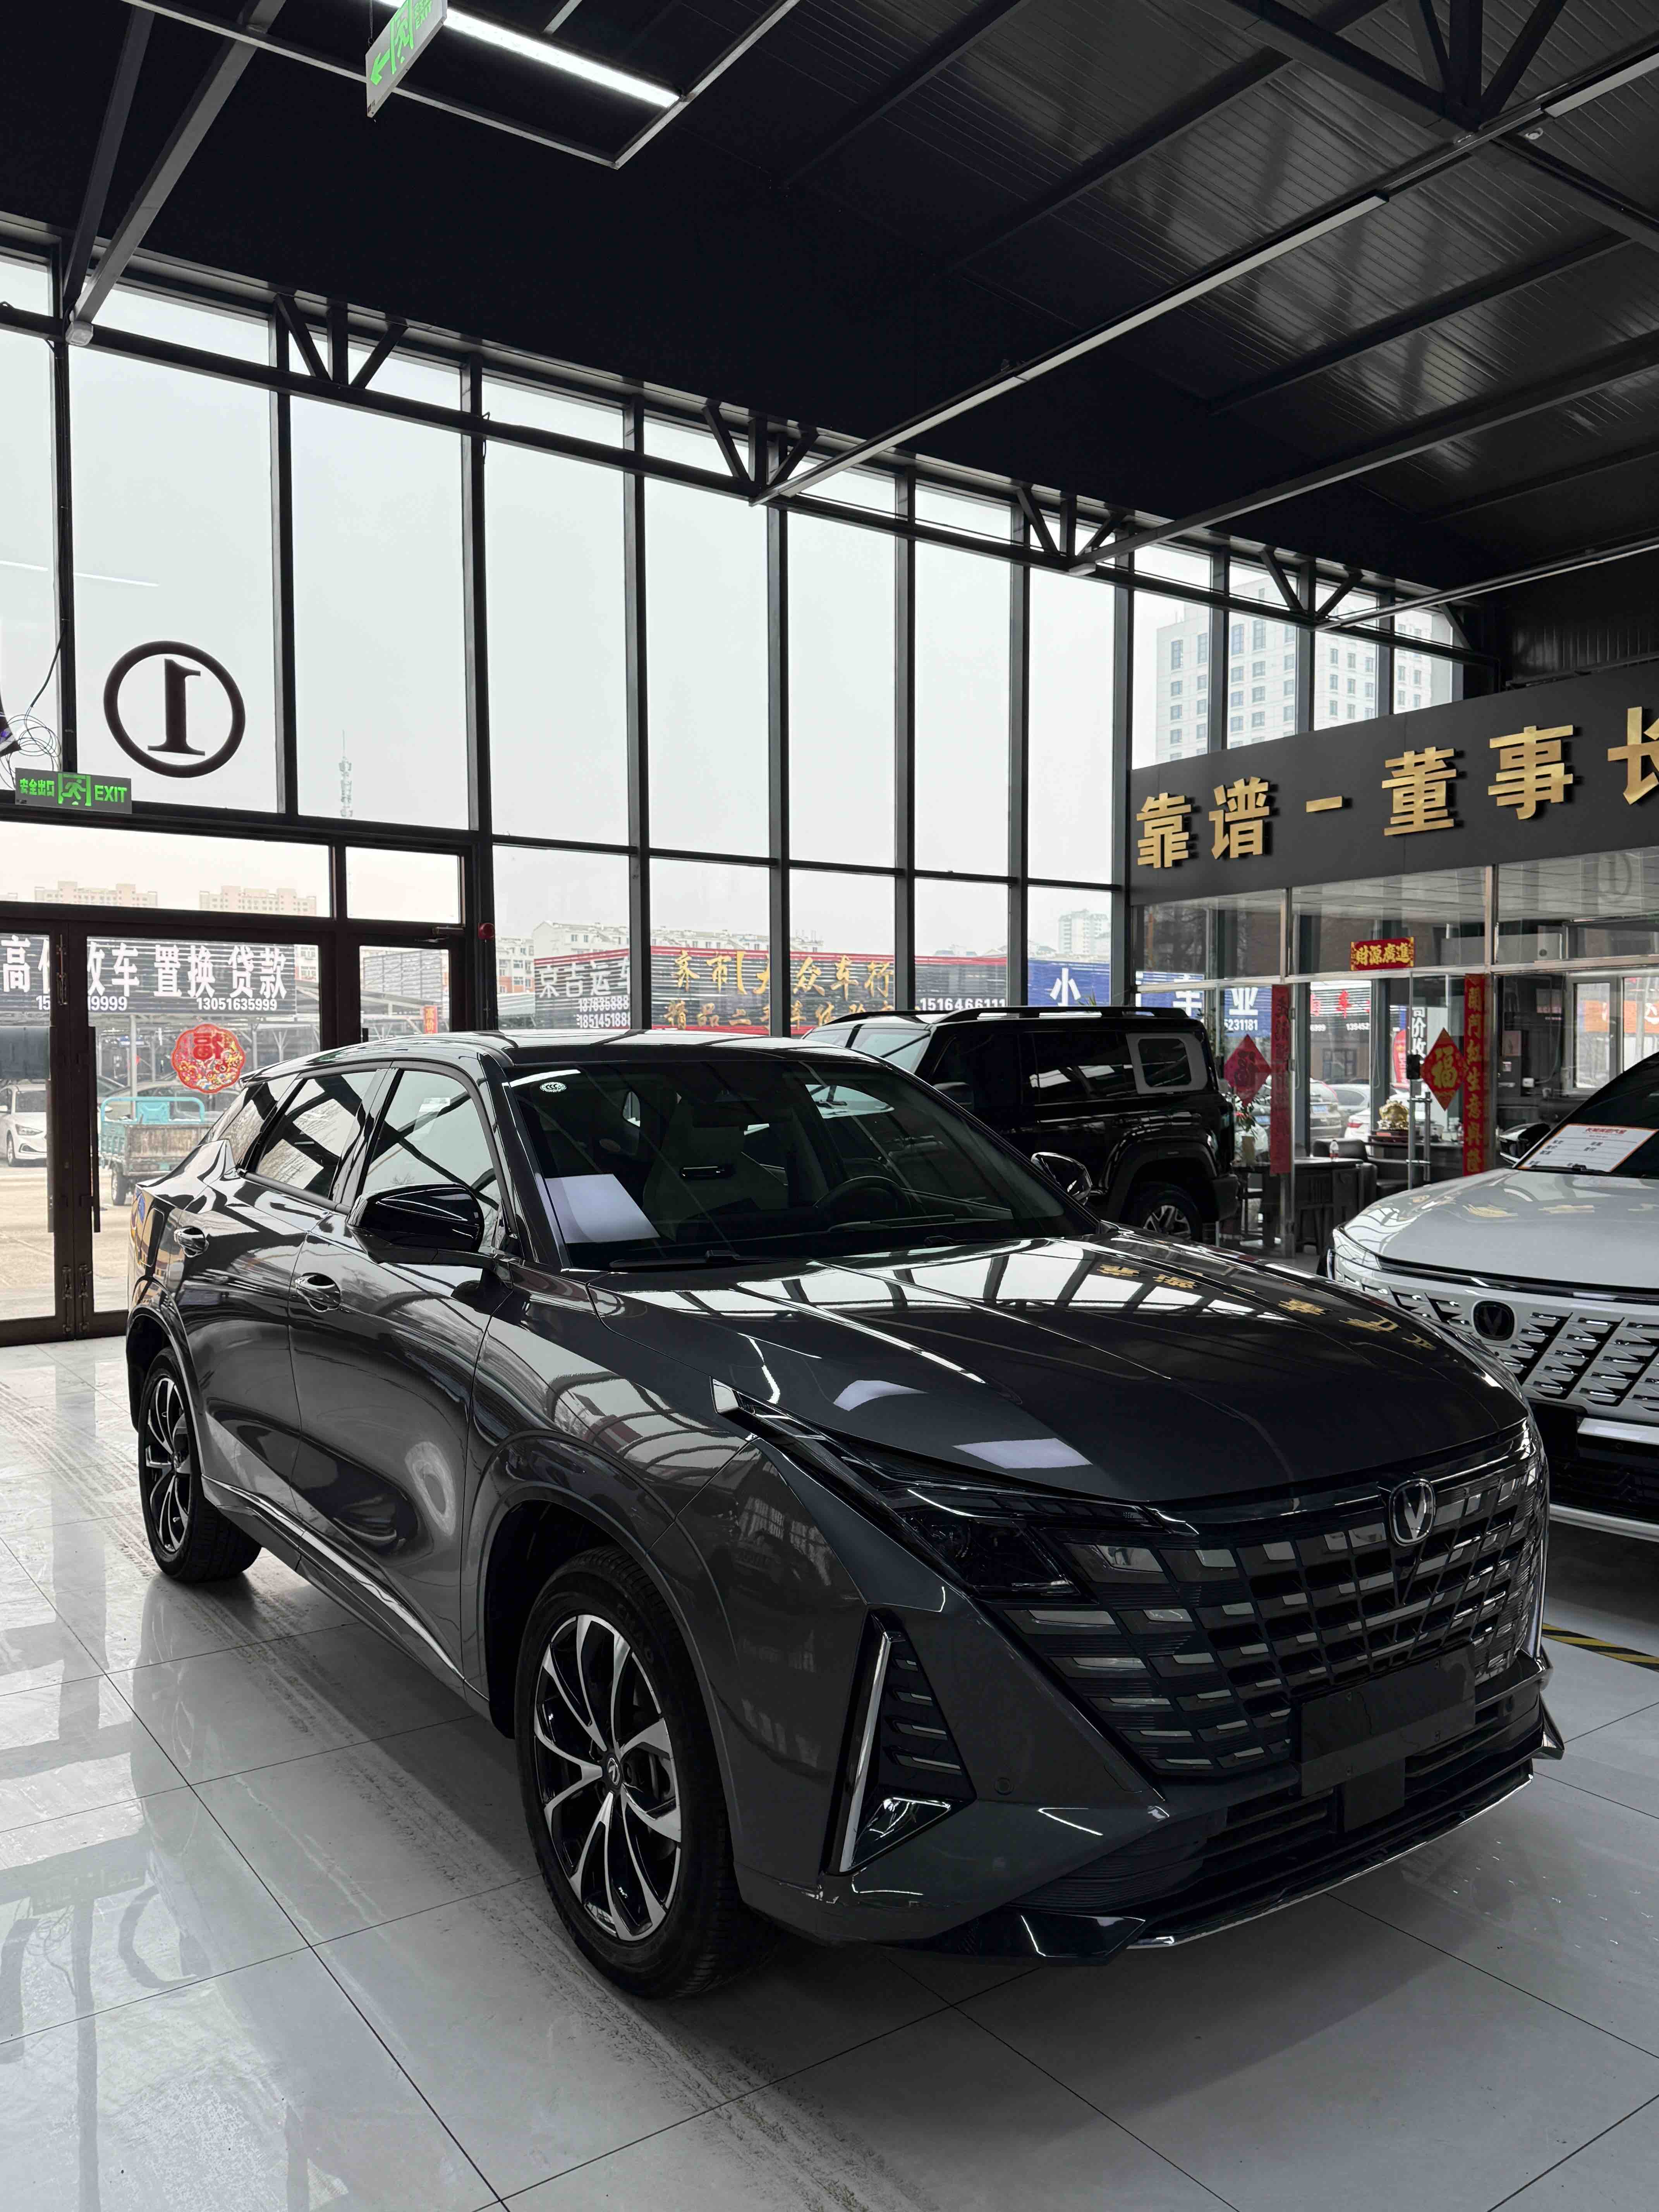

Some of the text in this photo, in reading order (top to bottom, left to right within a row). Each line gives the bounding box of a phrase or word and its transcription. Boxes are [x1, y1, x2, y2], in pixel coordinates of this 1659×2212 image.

[20, 778, 55, 797] 安全出口
[94, 785, 127, 803] EXIT
[153, 944, 216, 998] 置换
[228, 945, 287, 999] 贷款
[196, 998, 278, 1011] 13051635999
[1432, 1045, 1457, 1088] 福
